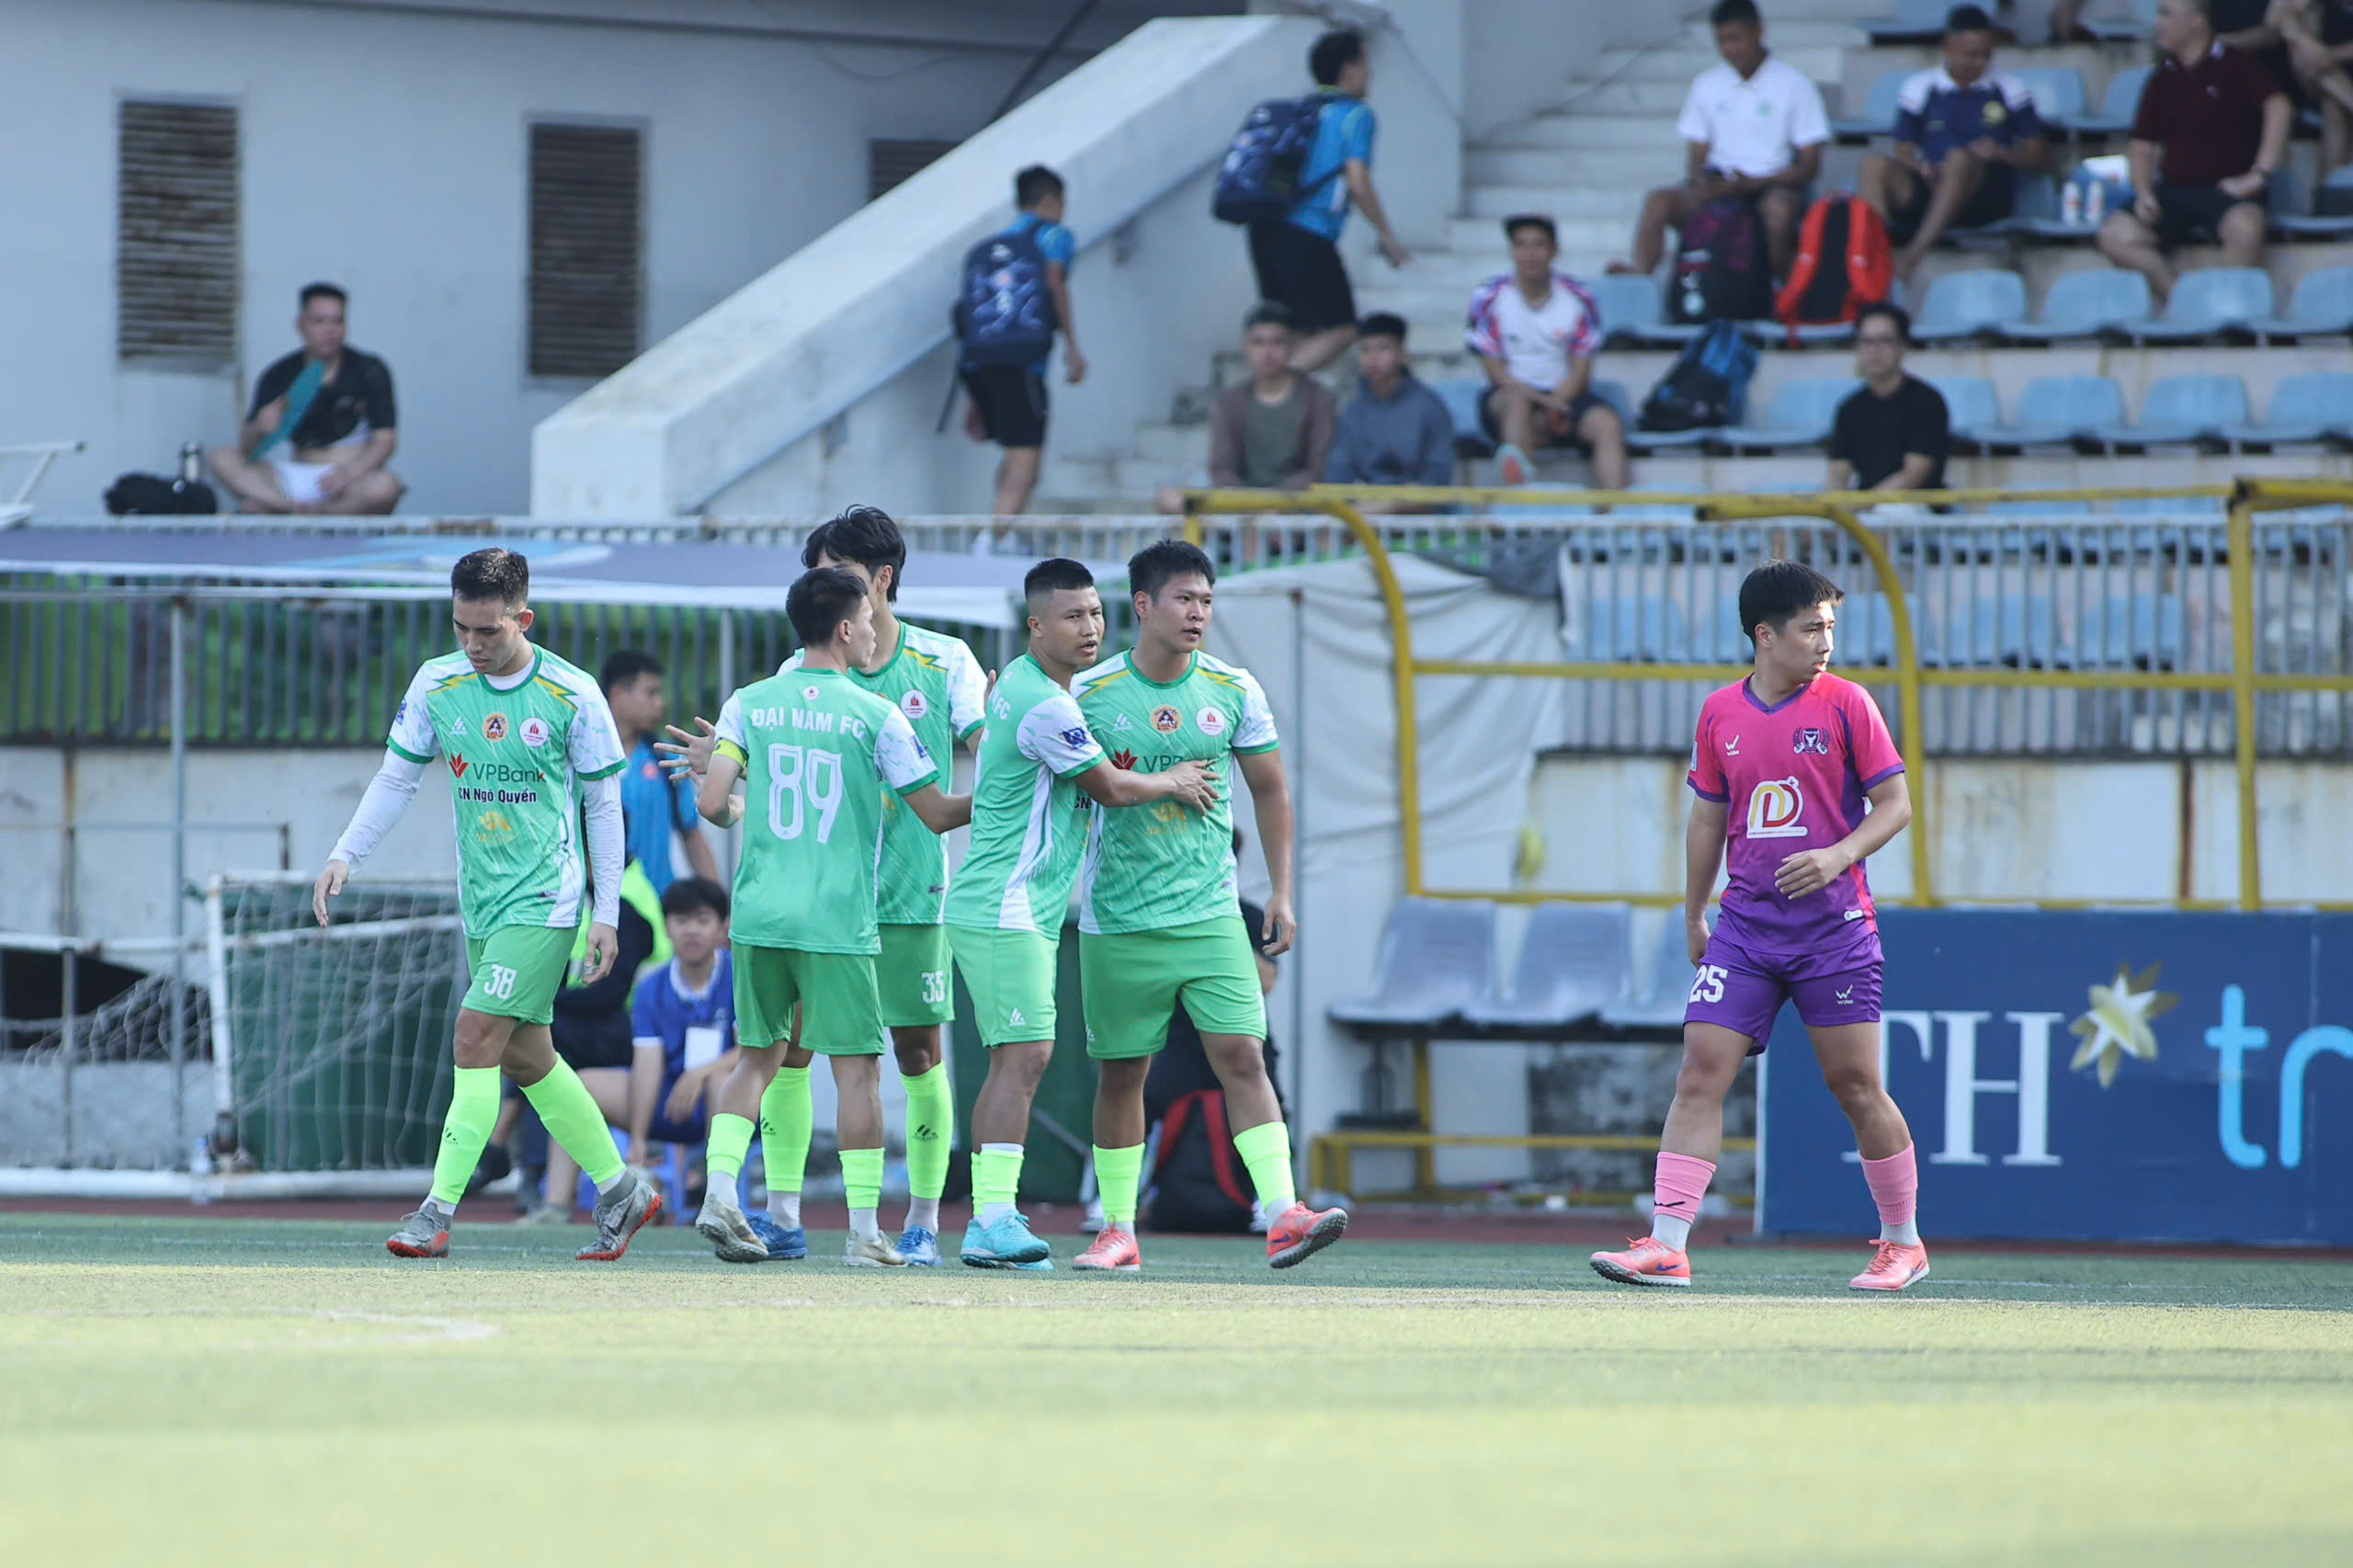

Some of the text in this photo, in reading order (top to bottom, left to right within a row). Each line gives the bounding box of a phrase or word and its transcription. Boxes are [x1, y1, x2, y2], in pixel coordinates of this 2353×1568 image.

[751, 706, 866, 739] ĐẠI NAM FC
[472, 762, 547, 783] VPBank
[473, 788, 494, 803] Ngô
[767, 743, 844, 845] 89
[484, 964, 517, 1000] 38
[921, 971, 946, 1003] 35
[1689, 965, 1728, 1003] 25
[1842, 1010, 2065, 1167] H
